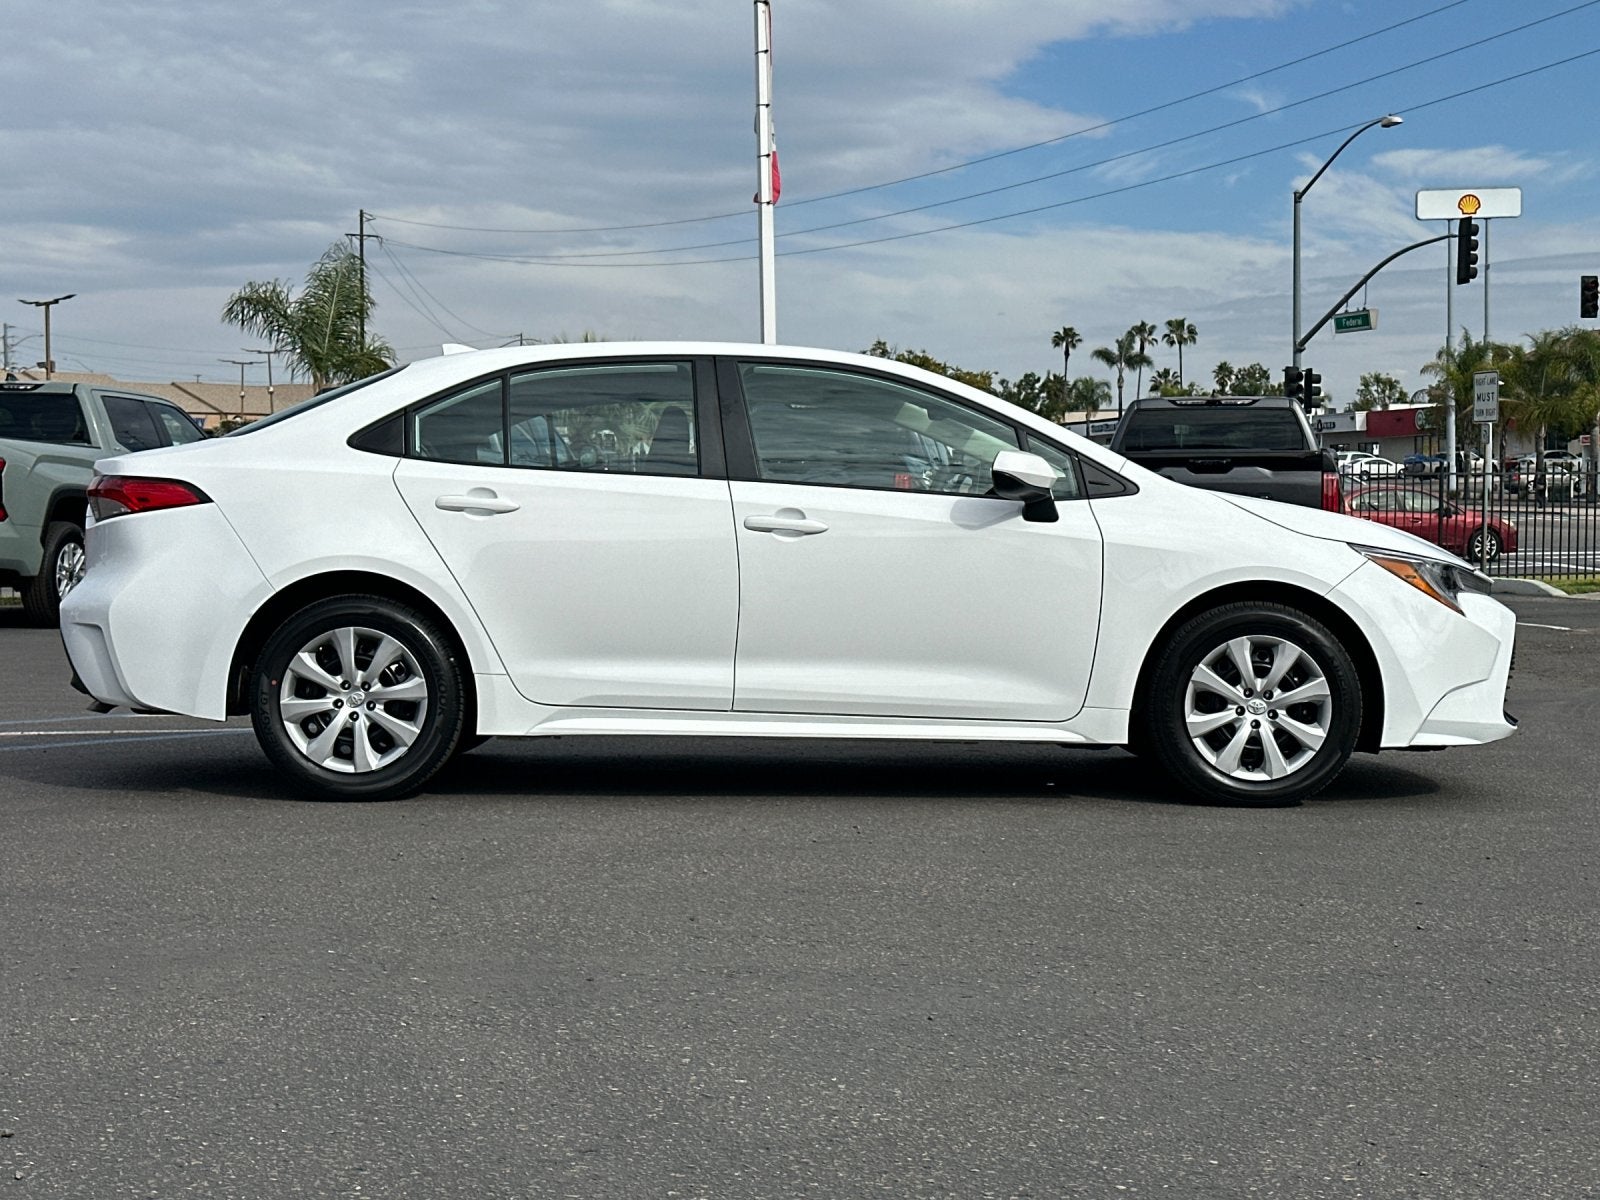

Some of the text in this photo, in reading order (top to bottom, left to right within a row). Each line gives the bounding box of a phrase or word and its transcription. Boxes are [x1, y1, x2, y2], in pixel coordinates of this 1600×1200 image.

[1342, 316, 1363, 327] Federal
[1486, 376, 1497, 386] LANE
[1476, 392, 1495, 402] MUST
